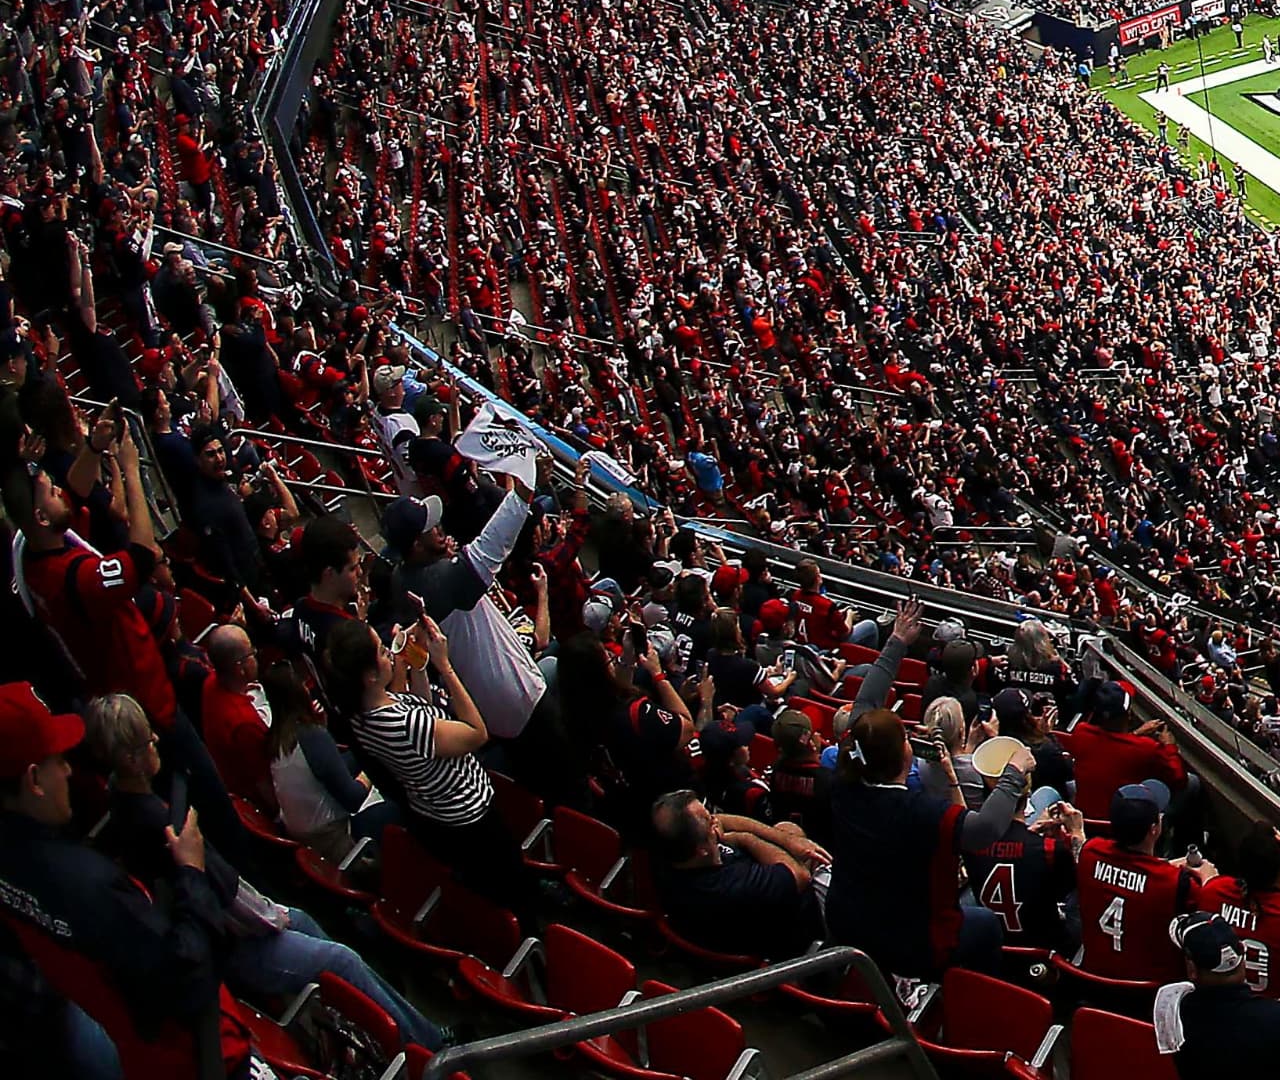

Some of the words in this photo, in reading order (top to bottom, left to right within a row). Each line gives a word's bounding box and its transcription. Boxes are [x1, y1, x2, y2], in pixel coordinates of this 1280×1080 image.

[1125, 24, 1151, 40] WILD
[99, 559, 125, 589] 10
[1093, 860, 1147, 894] WATSON
[979, 863, 1024, 932] 4
[1098, 896, 1125, 952] 4
[1221, 903, 1258, 932] WATT
